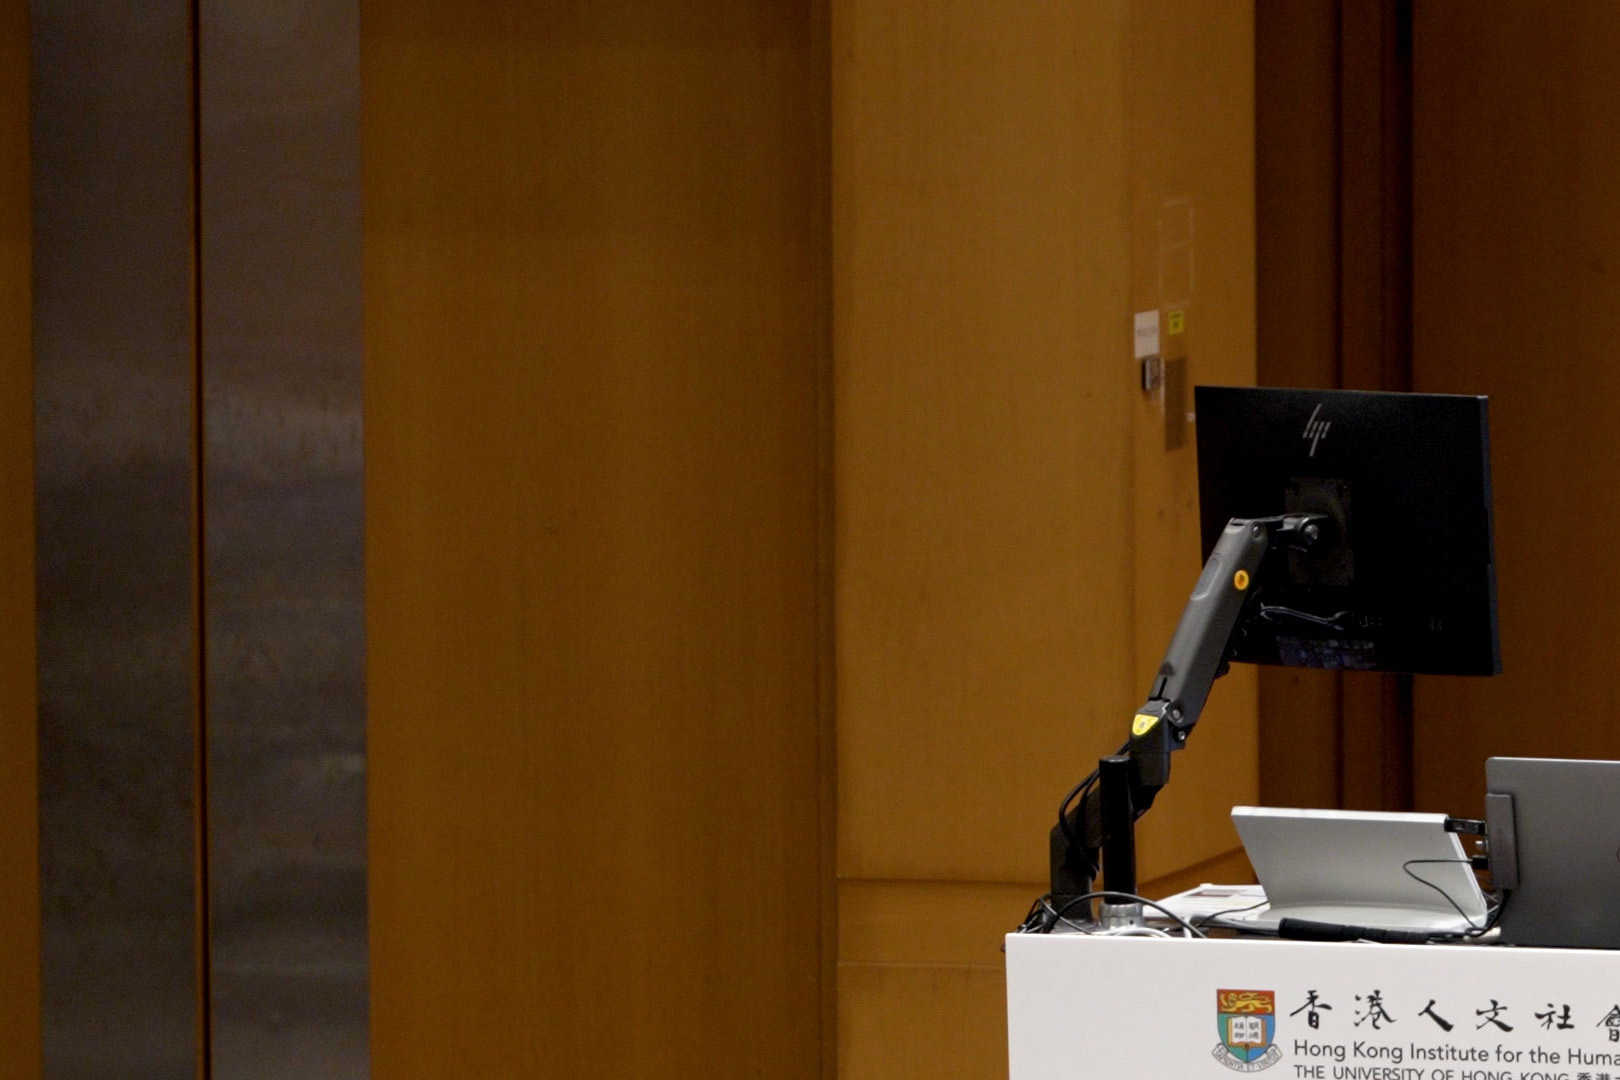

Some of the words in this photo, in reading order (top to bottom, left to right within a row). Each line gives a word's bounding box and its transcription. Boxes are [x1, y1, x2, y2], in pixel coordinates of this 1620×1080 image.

[1294, 1039, 1346, 1062] Hong
[1353, 1041, 1403, 1064] Kong
[1411, 1043, 1490, 1063] Institute
[1495, 1045, 1523, 1063] for
[1529, 1046, 1561, 1064] the
[1293, 1064, 1325, 1079] THE
